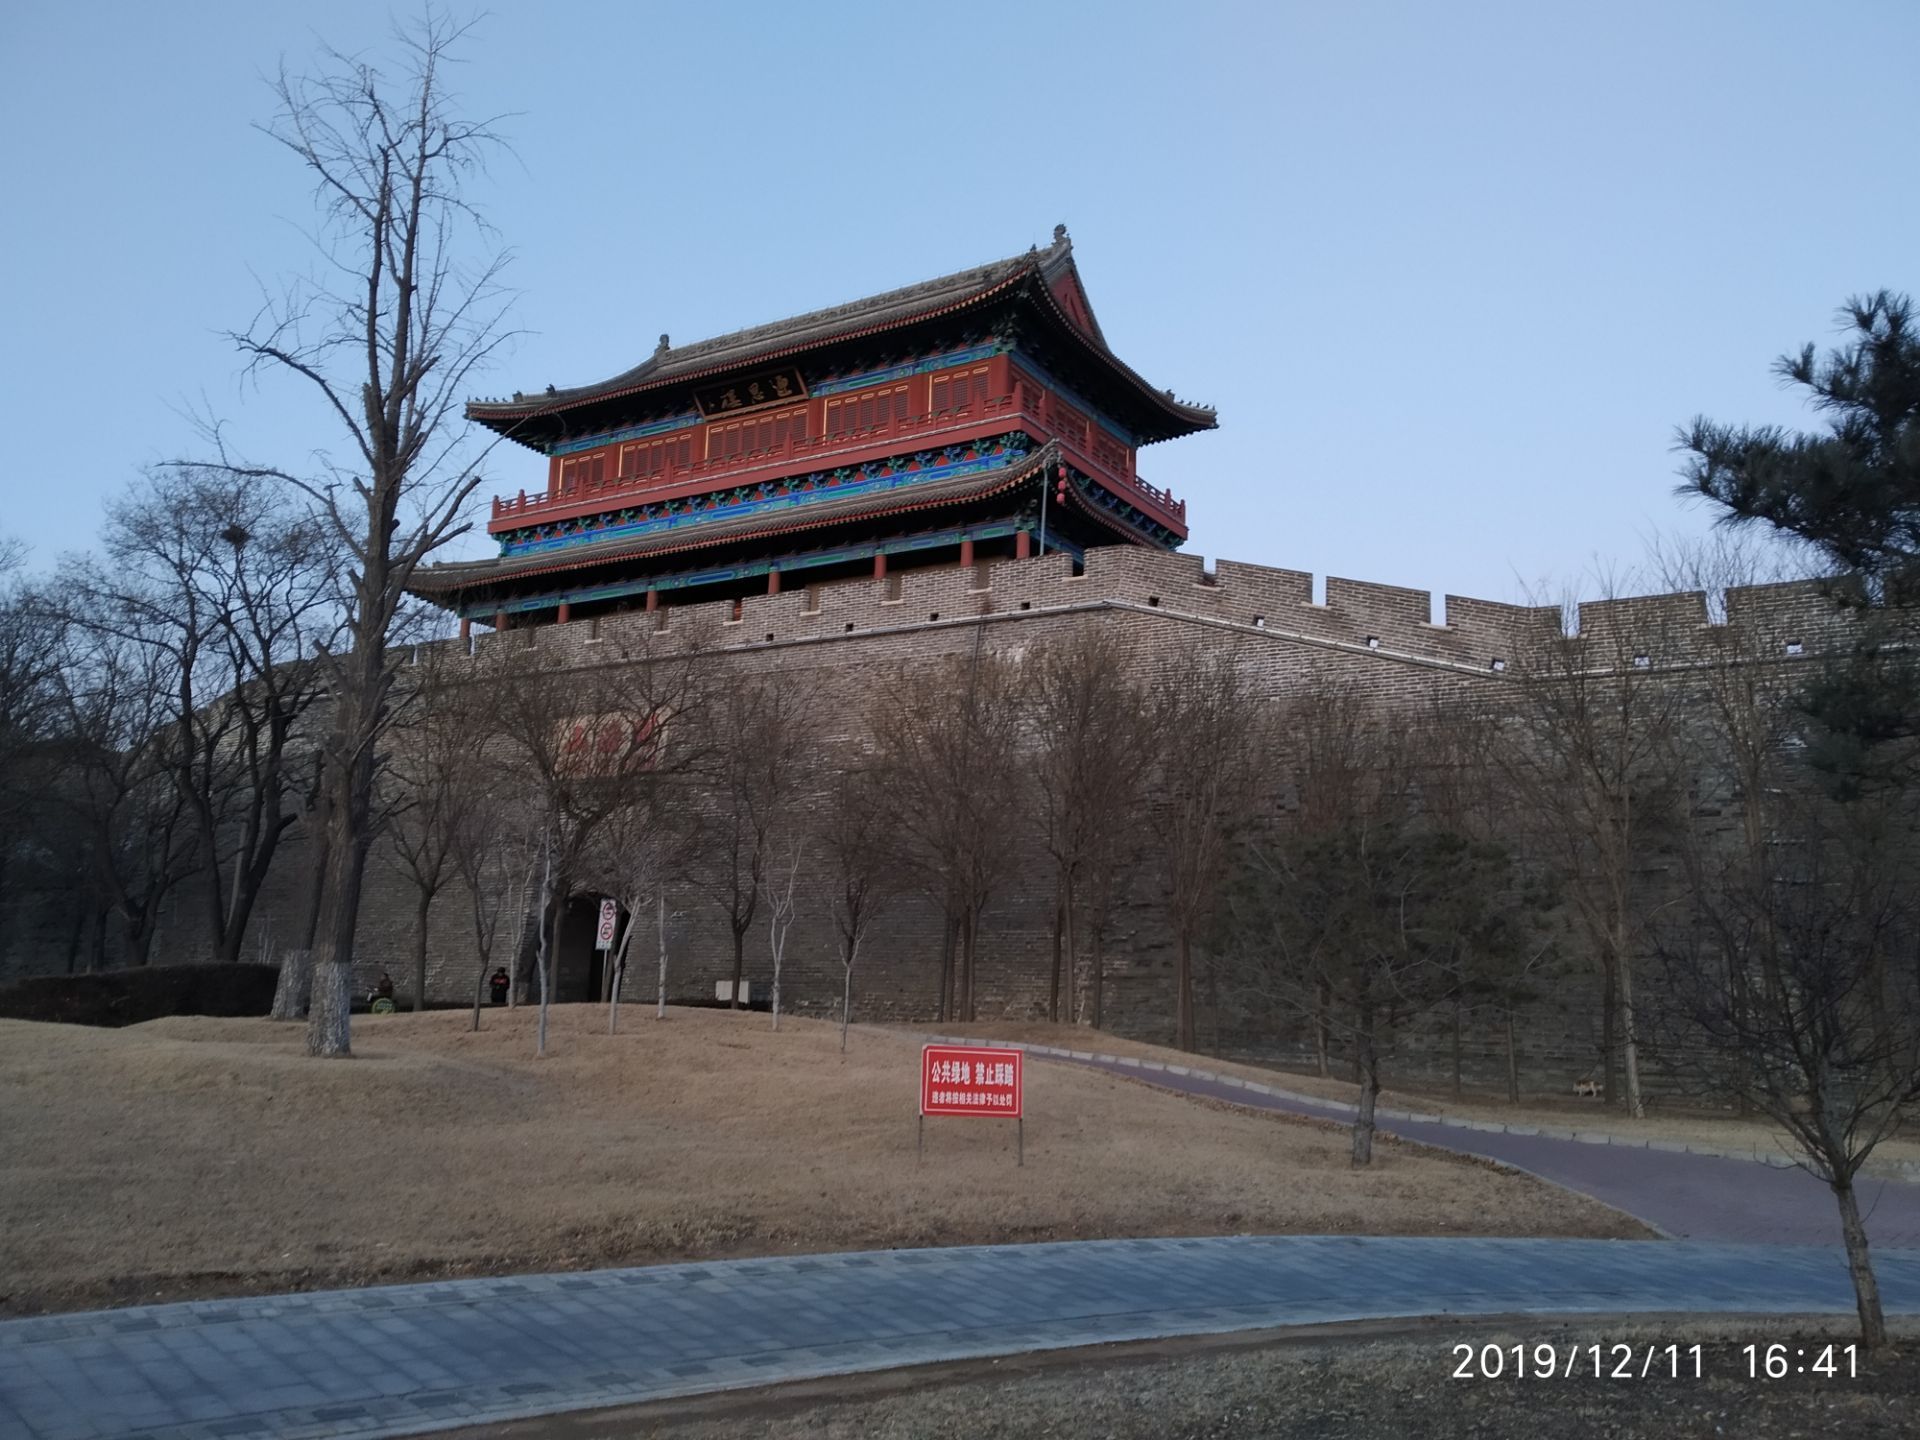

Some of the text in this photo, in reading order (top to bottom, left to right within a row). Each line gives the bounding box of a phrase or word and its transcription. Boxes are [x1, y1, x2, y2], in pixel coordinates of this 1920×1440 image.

[931, 1060, 1014, 1086] 公共绿地 禁止踩踏
